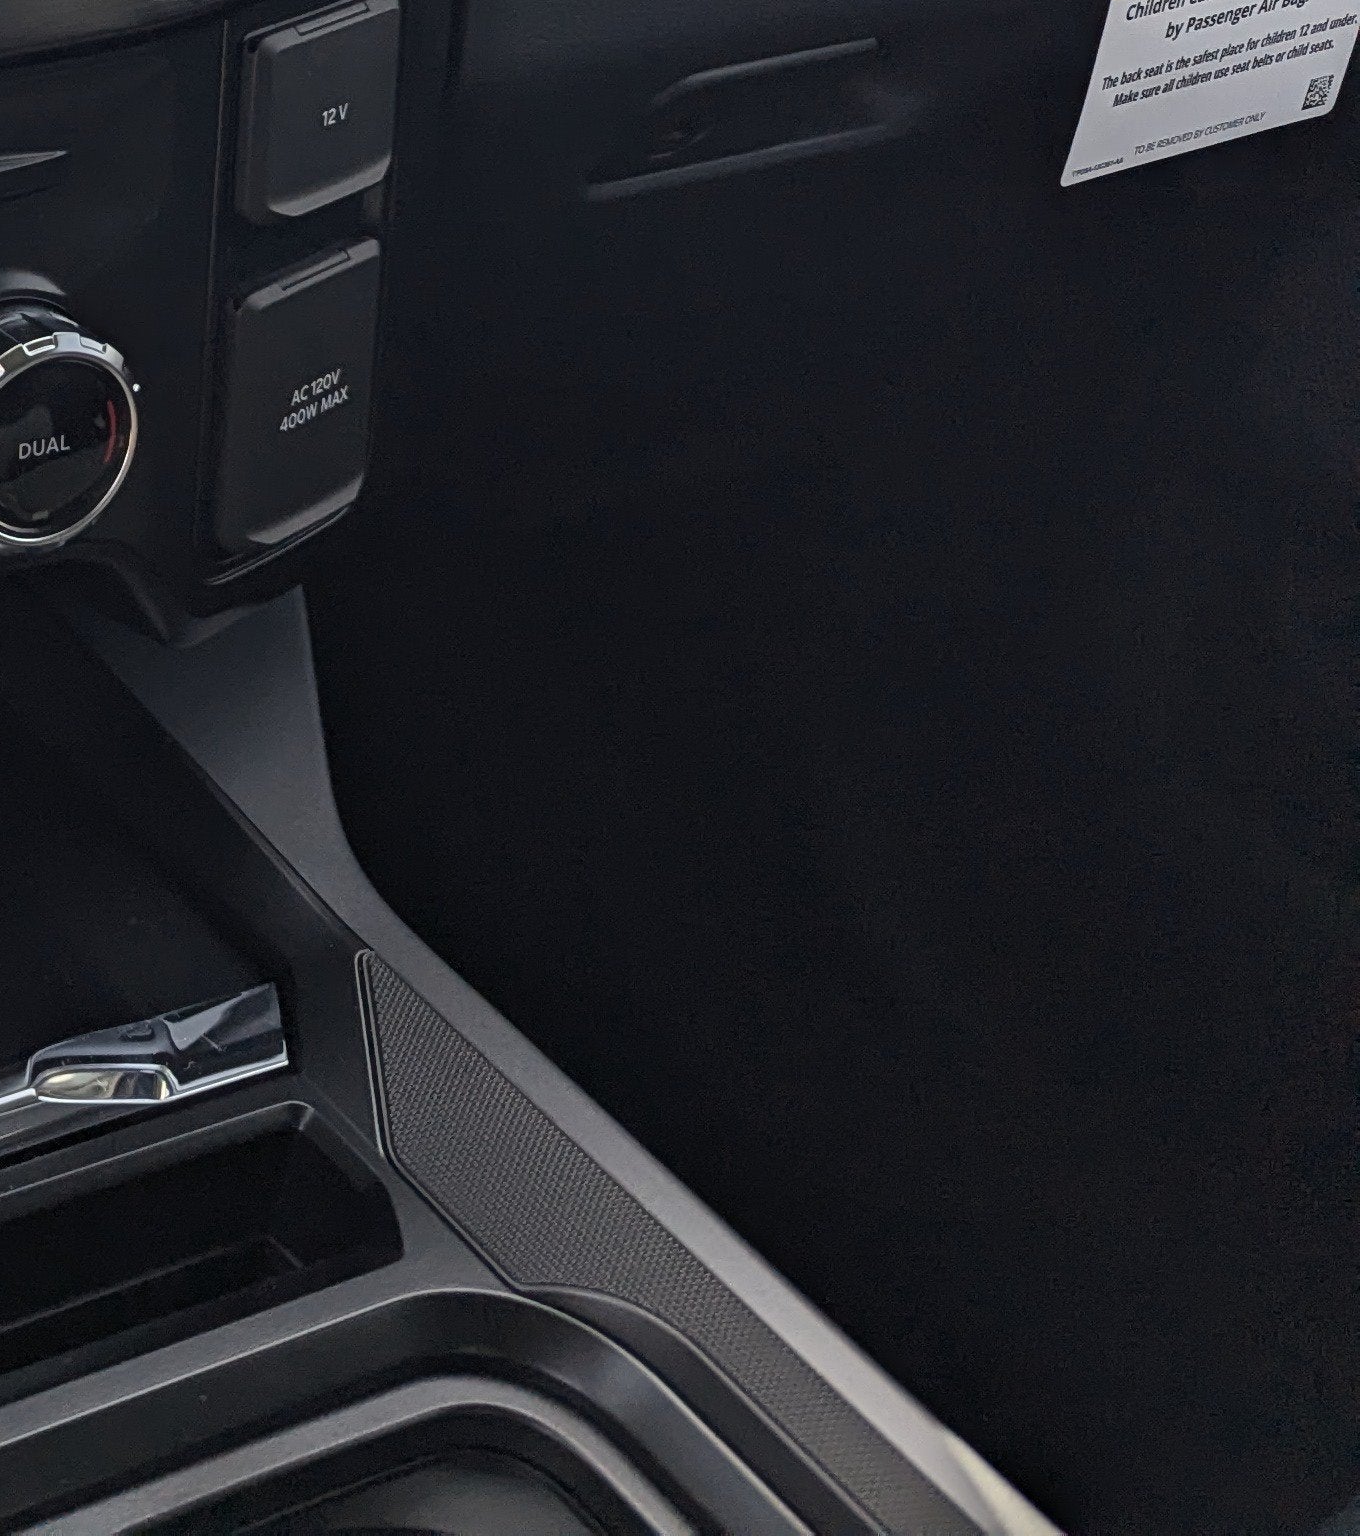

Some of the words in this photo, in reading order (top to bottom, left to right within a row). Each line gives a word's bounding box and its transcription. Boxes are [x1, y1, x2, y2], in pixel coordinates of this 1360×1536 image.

[1165, 19, 1184, 42] by
[1186, 1, 1258, 34] Passenger
[1101, 75, 1119, 92] The
[1120, 70, 1143, 87] back
[1143, 64, 1165, 80] seat
[1165, 60, 1175, 74] is
[1175, 55, 1191, 72] the
[1191, 48, 1220, 67] safest
[1219, 42, 1245, 62] place
[1245, 36, 1261, 53] for
[1260, 27, 1297, 48] children
[1299, 23, 1311, 39] 12
[1310, 20, 1329, 36] and
[1112, 89, 1139, 108] Make
[1140, 84, 1161, 101] sure
[1161, 77, 1176, 94] all
[1176, 70, 1212, 91] children
[1212, 66, 1231, 81] use
[1230, 59, 1251, 76] seat
[1251, 53, 1274, 71] belts
[1274, 49, 1286, 64] or
[1286, 43, 1308, 61] child
[320, 106, 338, 128] 12
[338, 102, 349, 119] V
[290, 384, 310, 406] AC
[310, 368, 341, 396] 120V
[280, 401, 319, 432] 400W
[320, 384, 350, 414] MAX
[17, 433, 71, 461] DUAL
